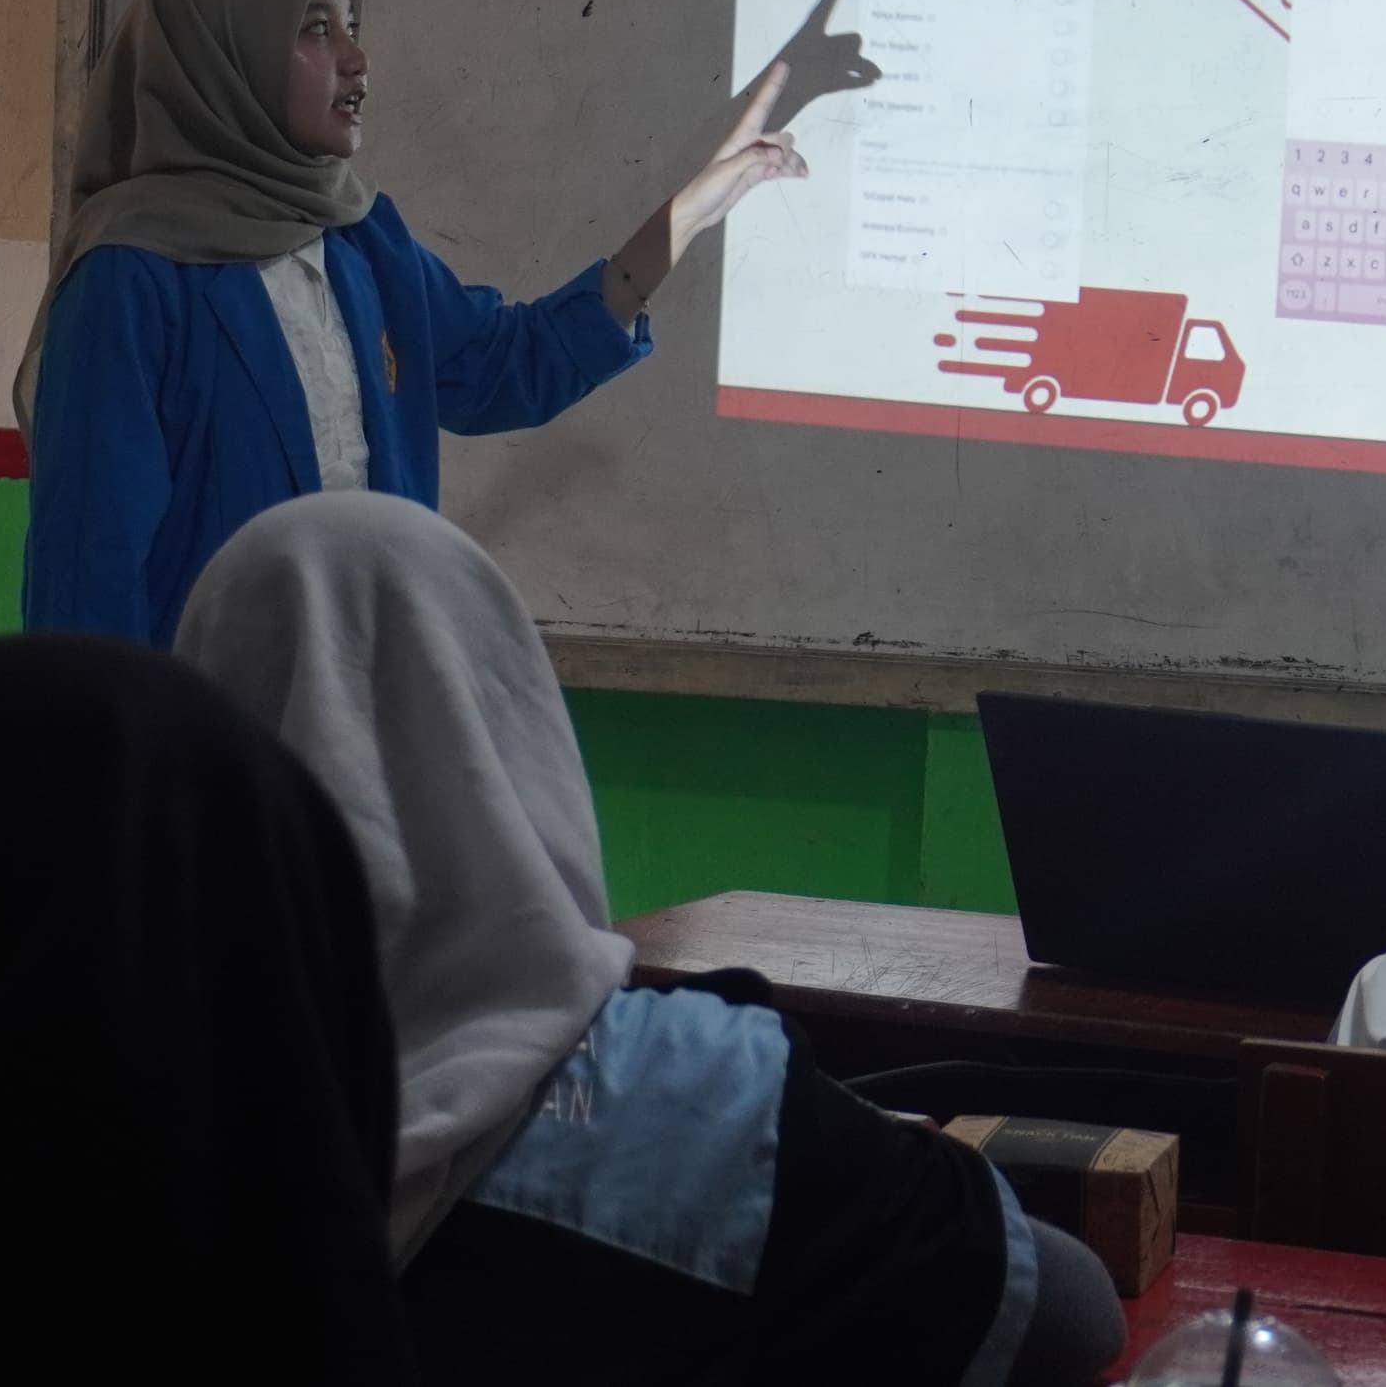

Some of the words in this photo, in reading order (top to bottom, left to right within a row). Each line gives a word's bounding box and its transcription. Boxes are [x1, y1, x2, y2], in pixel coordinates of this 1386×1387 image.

[1317, 149, 1325, 163] 2
[1341, 151, 1349, 165] 3
[1364, 153, 1373, 166] 4
[1291, 183, 1301, 197] q
[1314, 186, 1326, 197] w
[1339, 187, 1348, 198] e
[1363, 188, 1370, 199] r
[1301, 219, 1310, 231] a
[1325, 221, 1333, 233] s
[1349, 220, 1358, 234] d
[1374, 221, 1380, 235] f
[1324, 255, 1332, 268] z
[1347, 257, 1356, 269] x
[1370, 259, 1380, 271] c
